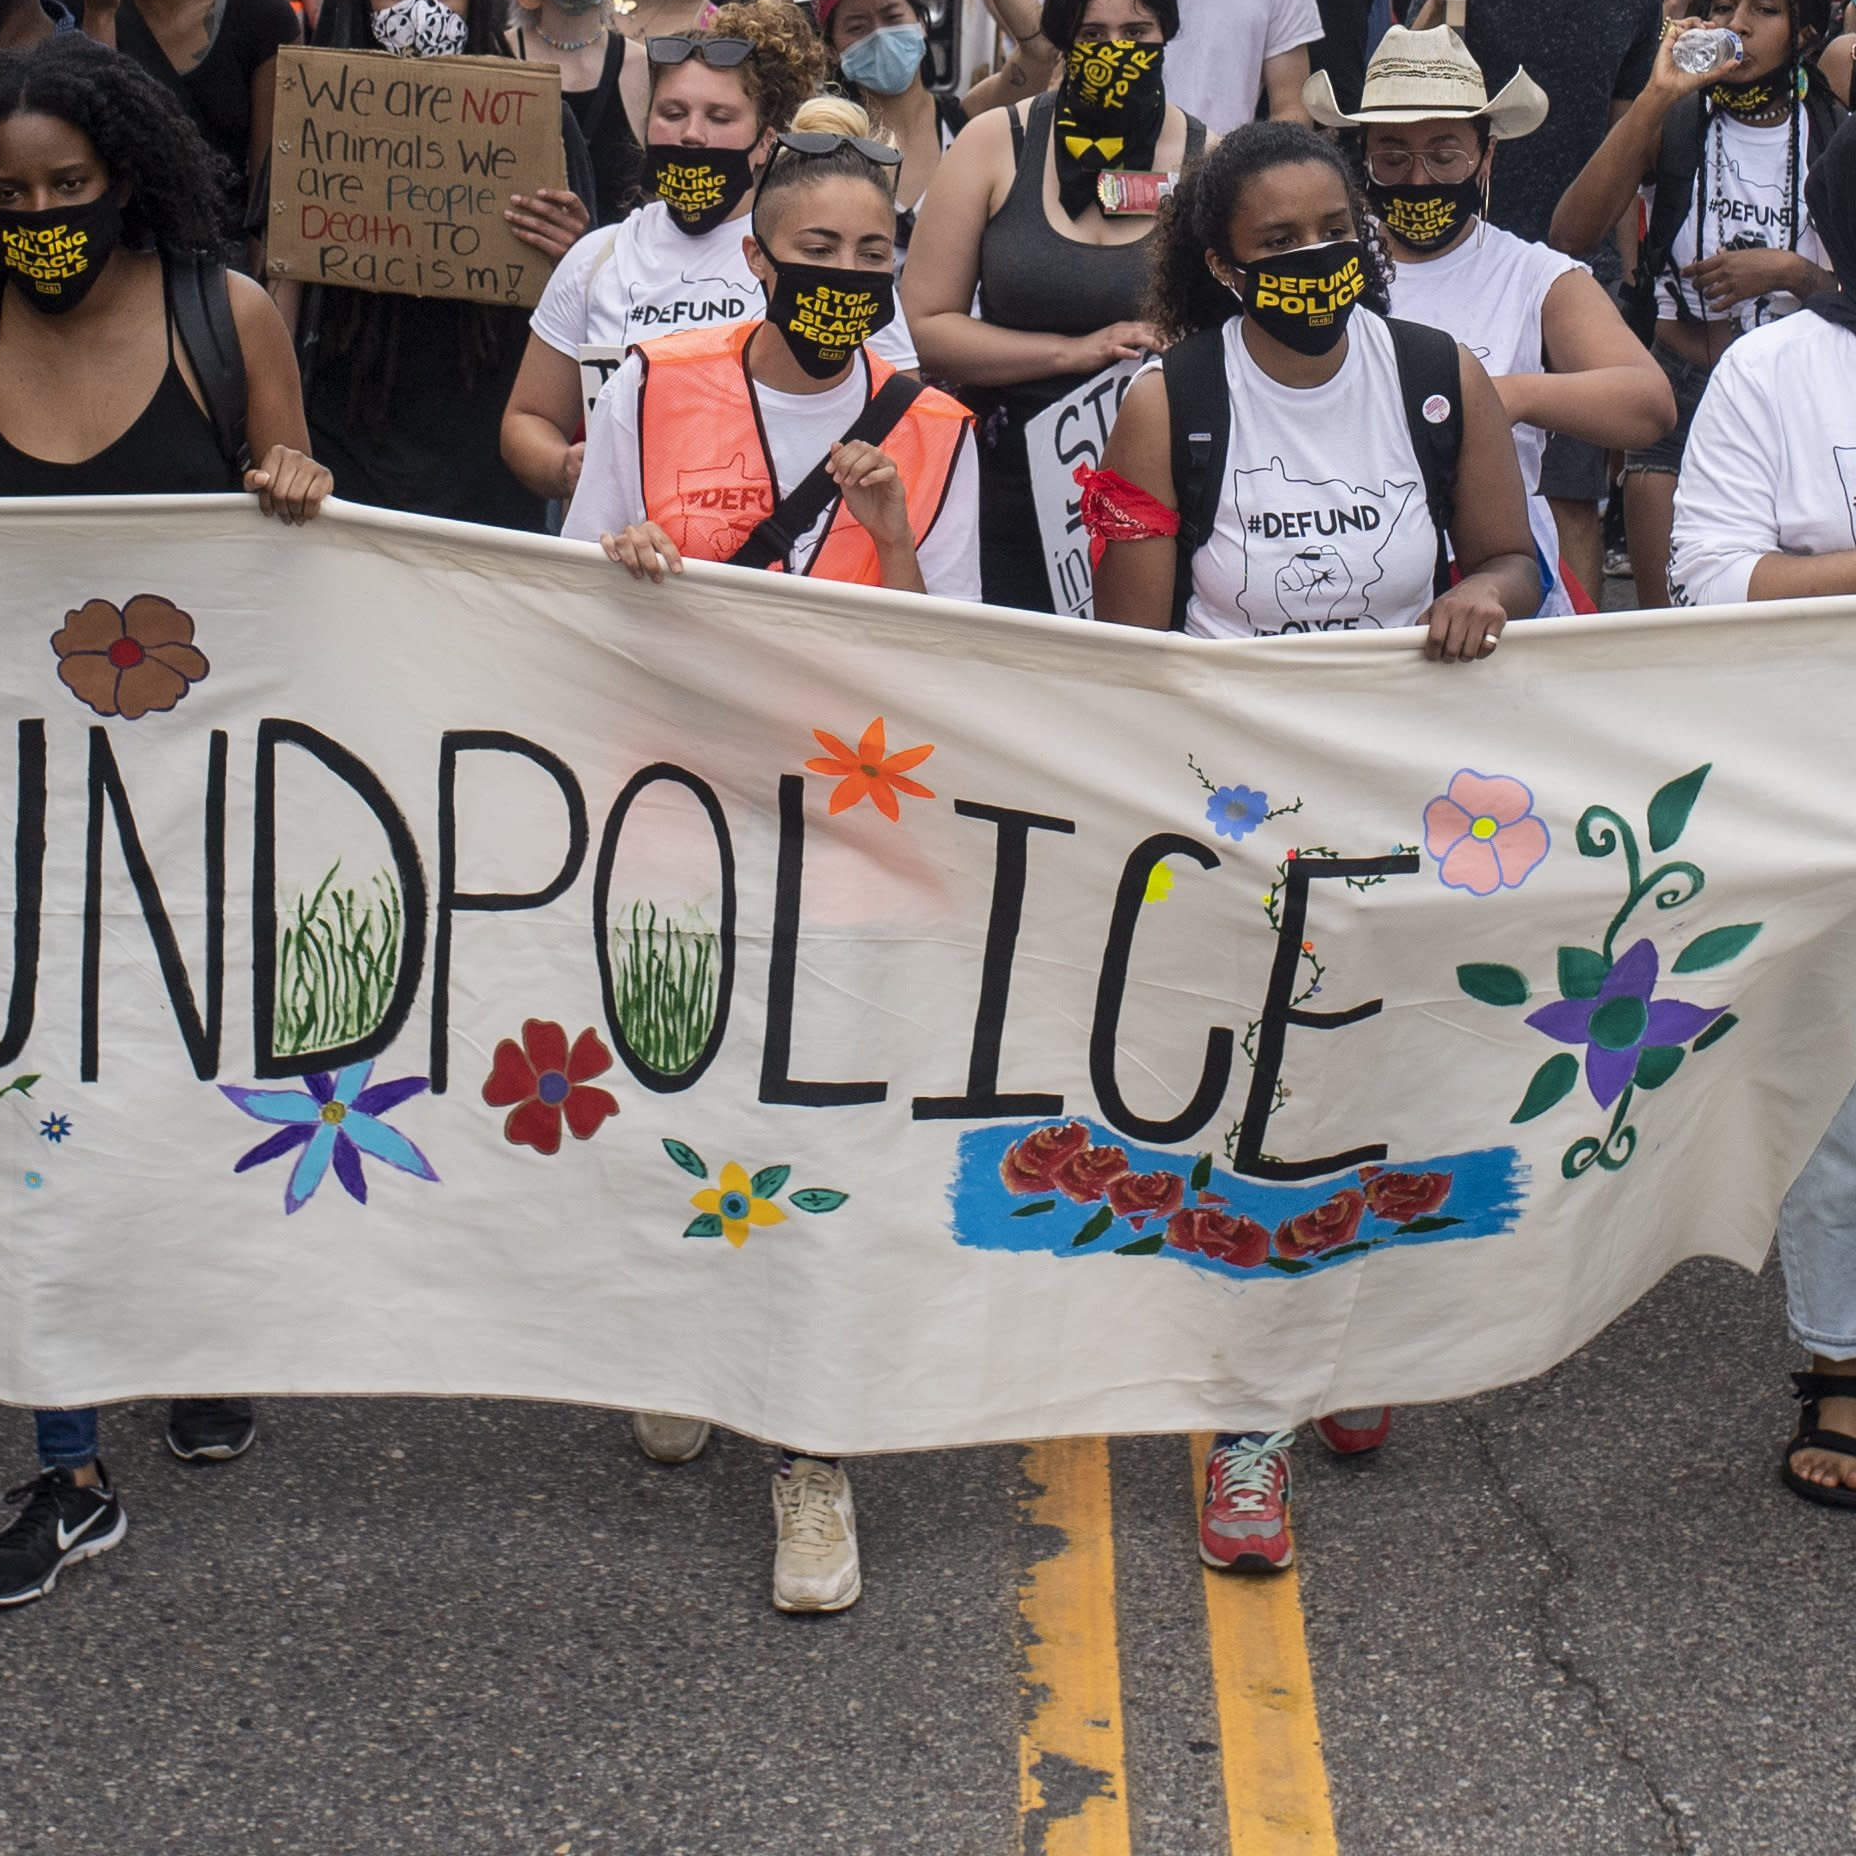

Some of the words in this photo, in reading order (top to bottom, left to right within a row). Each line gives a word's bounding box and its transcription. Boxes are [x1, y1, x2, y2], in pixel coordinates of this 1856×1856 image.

[298, 61, 376, 115] We
[383, 82, 454, 124] are
[459, 88, 539, 127] NOT
[299, 117, 446, 172] Animals
[455, 142, 519, 181] We
[655, 169, 727, 191] KILLING
[666, 162, 712, 179] STOP
[296, 165, 364, 202] are
[384, 173, 496, 221] People
[657, 184, 724, 204] BLACK
[1392, 198, 1442, 214] STOP
[17, 223, 69, 242] STOP
[300, 203, 414, 246] Death
[1386, 212, 1455, 232] BLACK
[2, 228, 88, 257] KILLING
[4, 256, 89, 280] PEOPLE
[6, 246, 85, 269] BLACK
[1257, 255, 1361, 295] DEFUND
[795, 292, 880, 320] KILLING
[815, 285, 871, 307] STOP
[1255, 272, 1365, 315] POLICE
[629, 298, 746, 326] #DEFUND
[797, 308, 872, 334] BLACK
[787, 319, 874, 347] PEOPLE
[1246, 504, 1381, 540] #DEFUND
